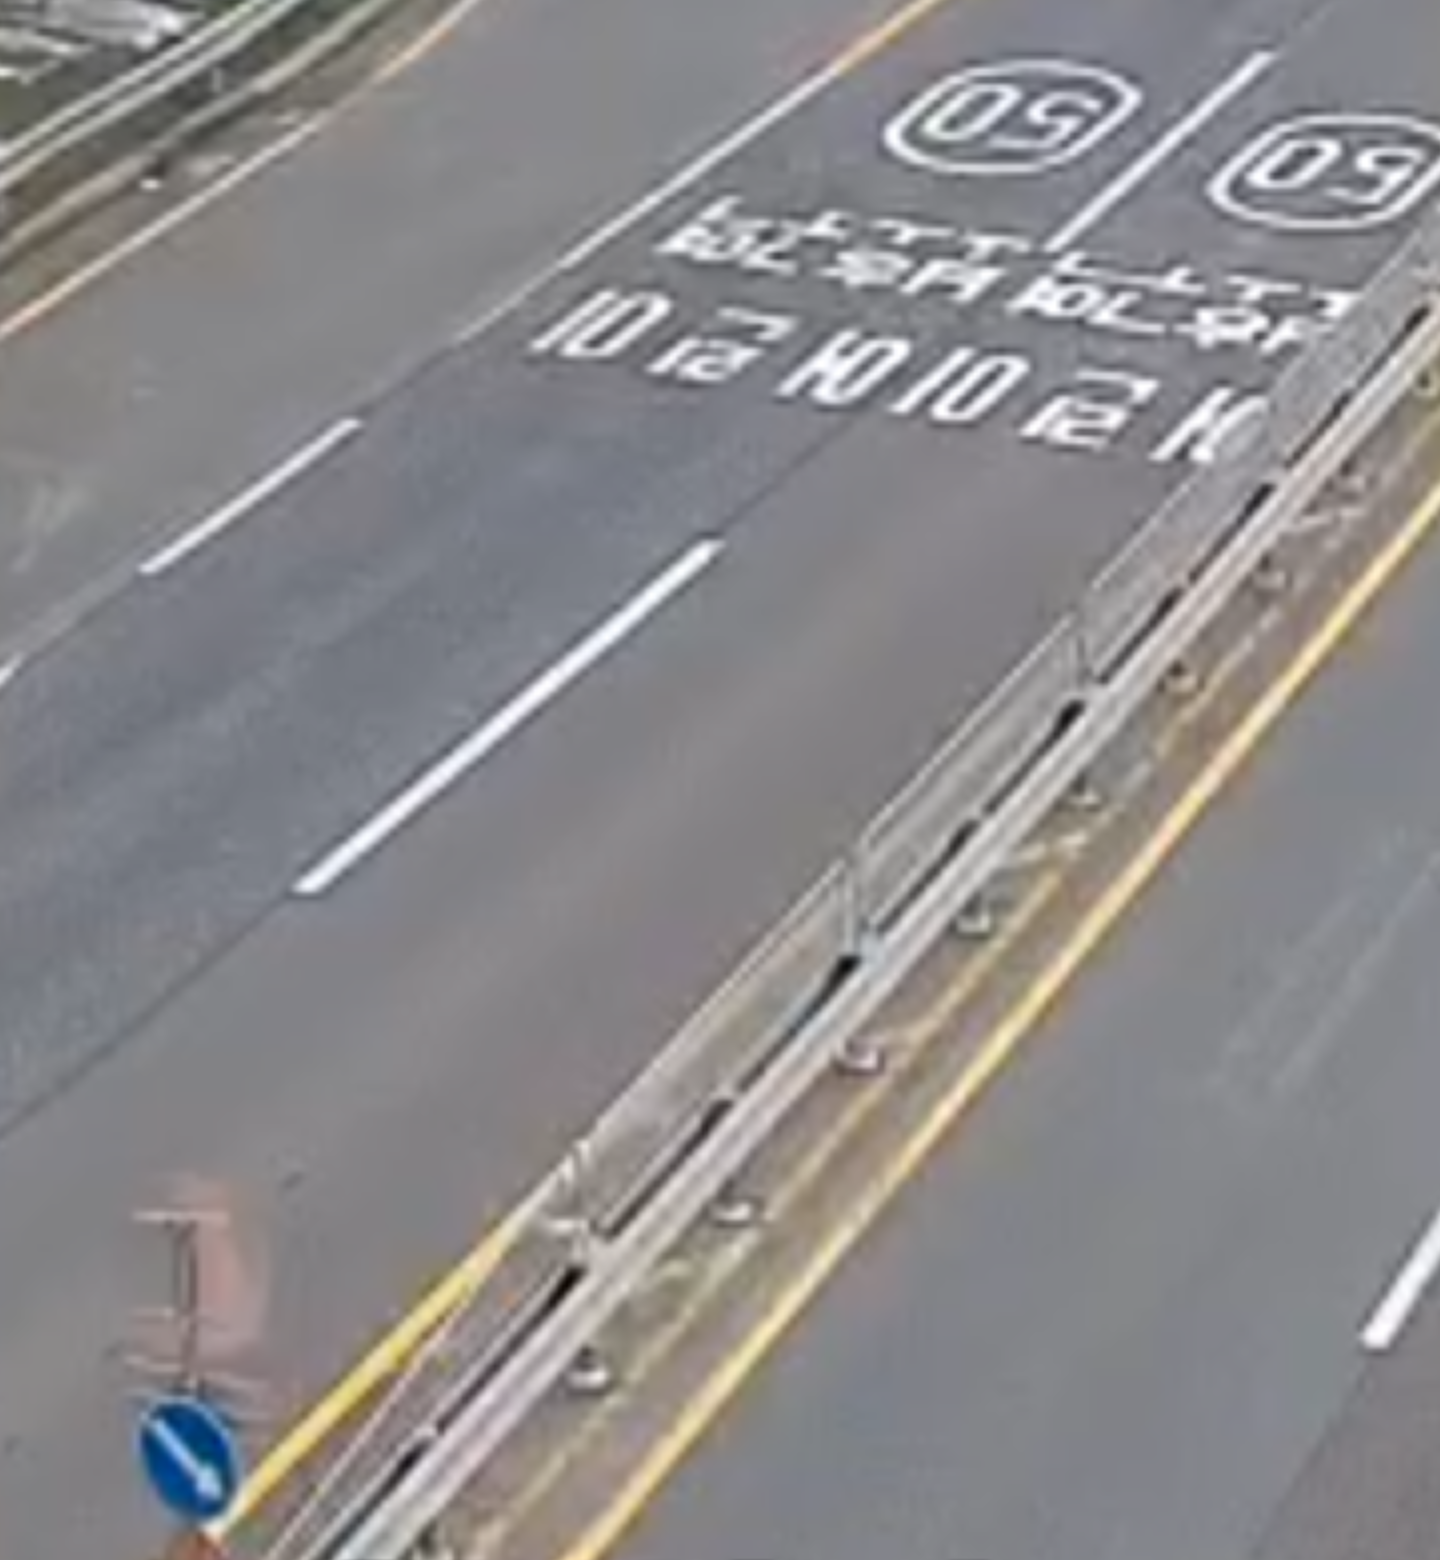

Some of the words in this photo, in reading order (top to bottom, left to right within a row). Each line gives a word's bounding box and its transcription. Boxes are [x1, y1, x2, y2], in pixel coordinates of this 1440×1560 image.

[919, 82, 1103, 152] 50
[1244, 136, 1428, 206] 50
[530, 288, 910, 404] 어린이
